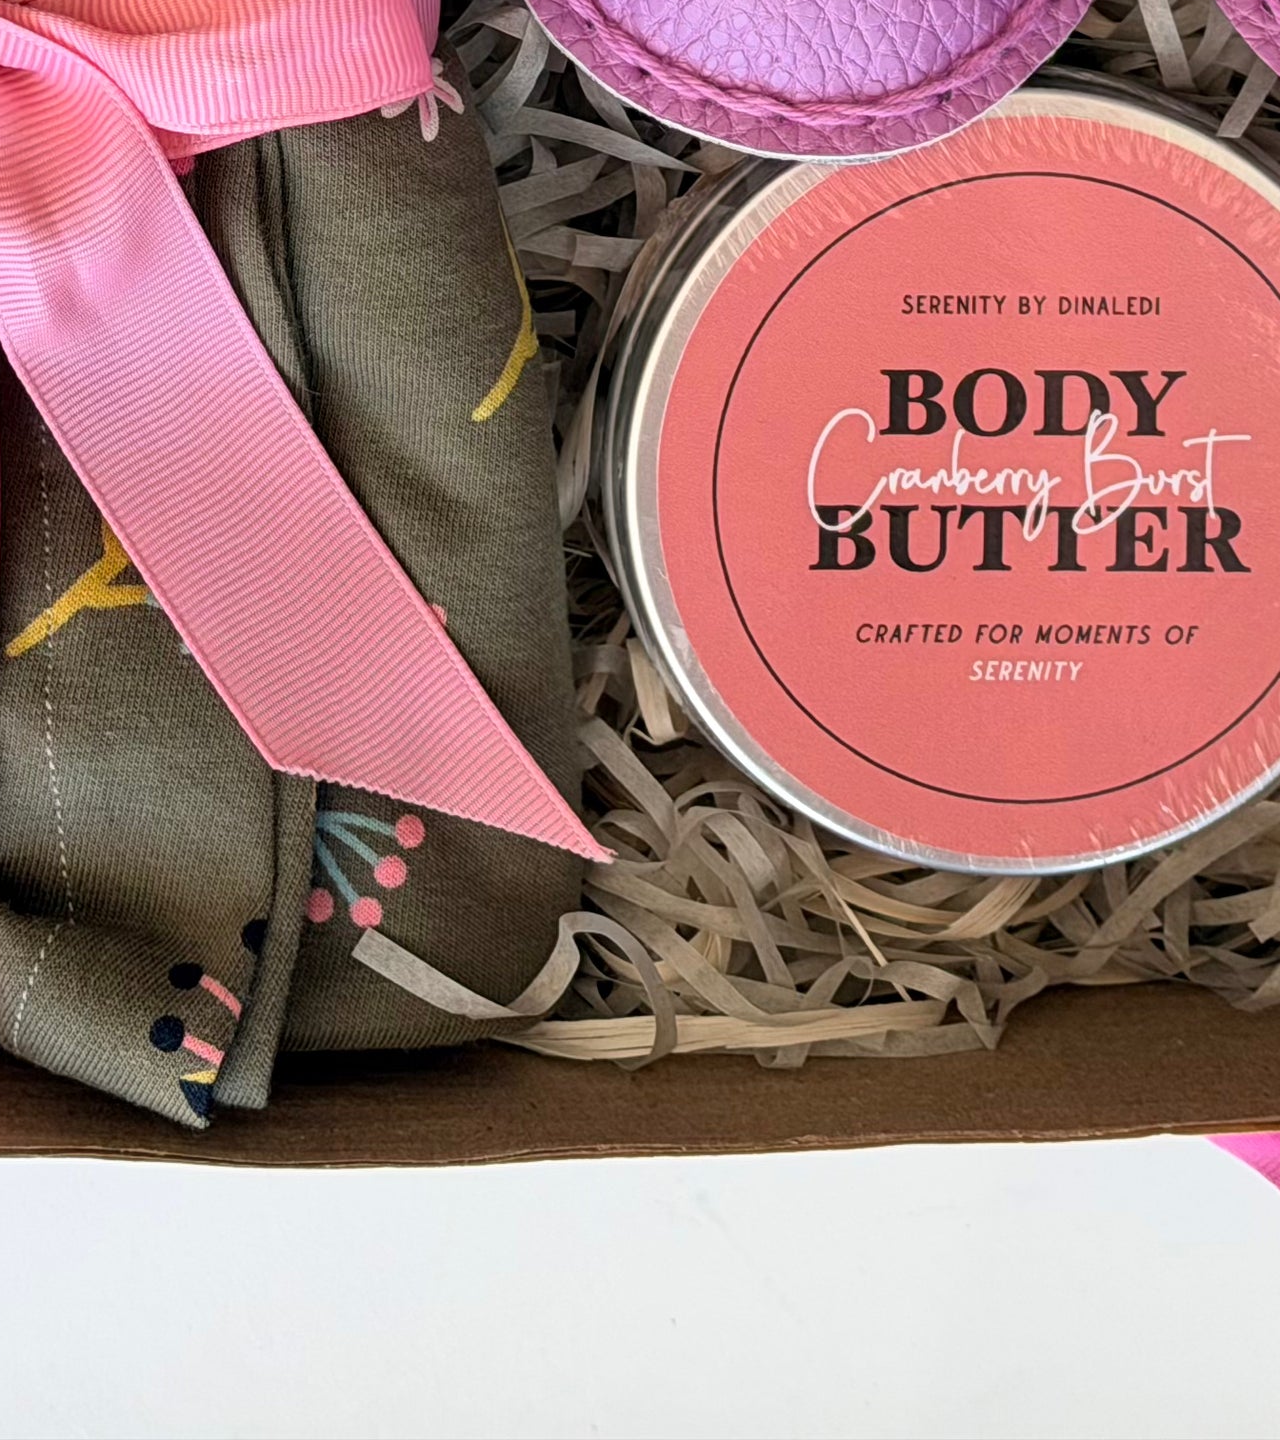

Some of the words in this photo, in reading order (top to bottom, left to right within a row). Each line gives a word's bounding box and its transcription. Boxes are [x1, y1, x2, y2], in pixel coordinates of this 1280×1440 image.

[901, 294, 1007, 315] SERENITY
[1018, 295, 1047, 315] BY
[1058, 296, 1161, 316] DINALEDI
[879, 368, 1188, 437] BODY
[808, 408, 1061, 541] Cranberry
[1071, 409, 1251, 534] Burst
[809, 504, 1252, 573] BUTTER
[856, 623, 963, 644] CRAFTED
[976, 623, 1023, 645] FOR
[1035, 624, 1151, 645] MOMENTS
[1165, 625, 1199, 645] OF
[969, 660, 1083, 681] SERENITY
